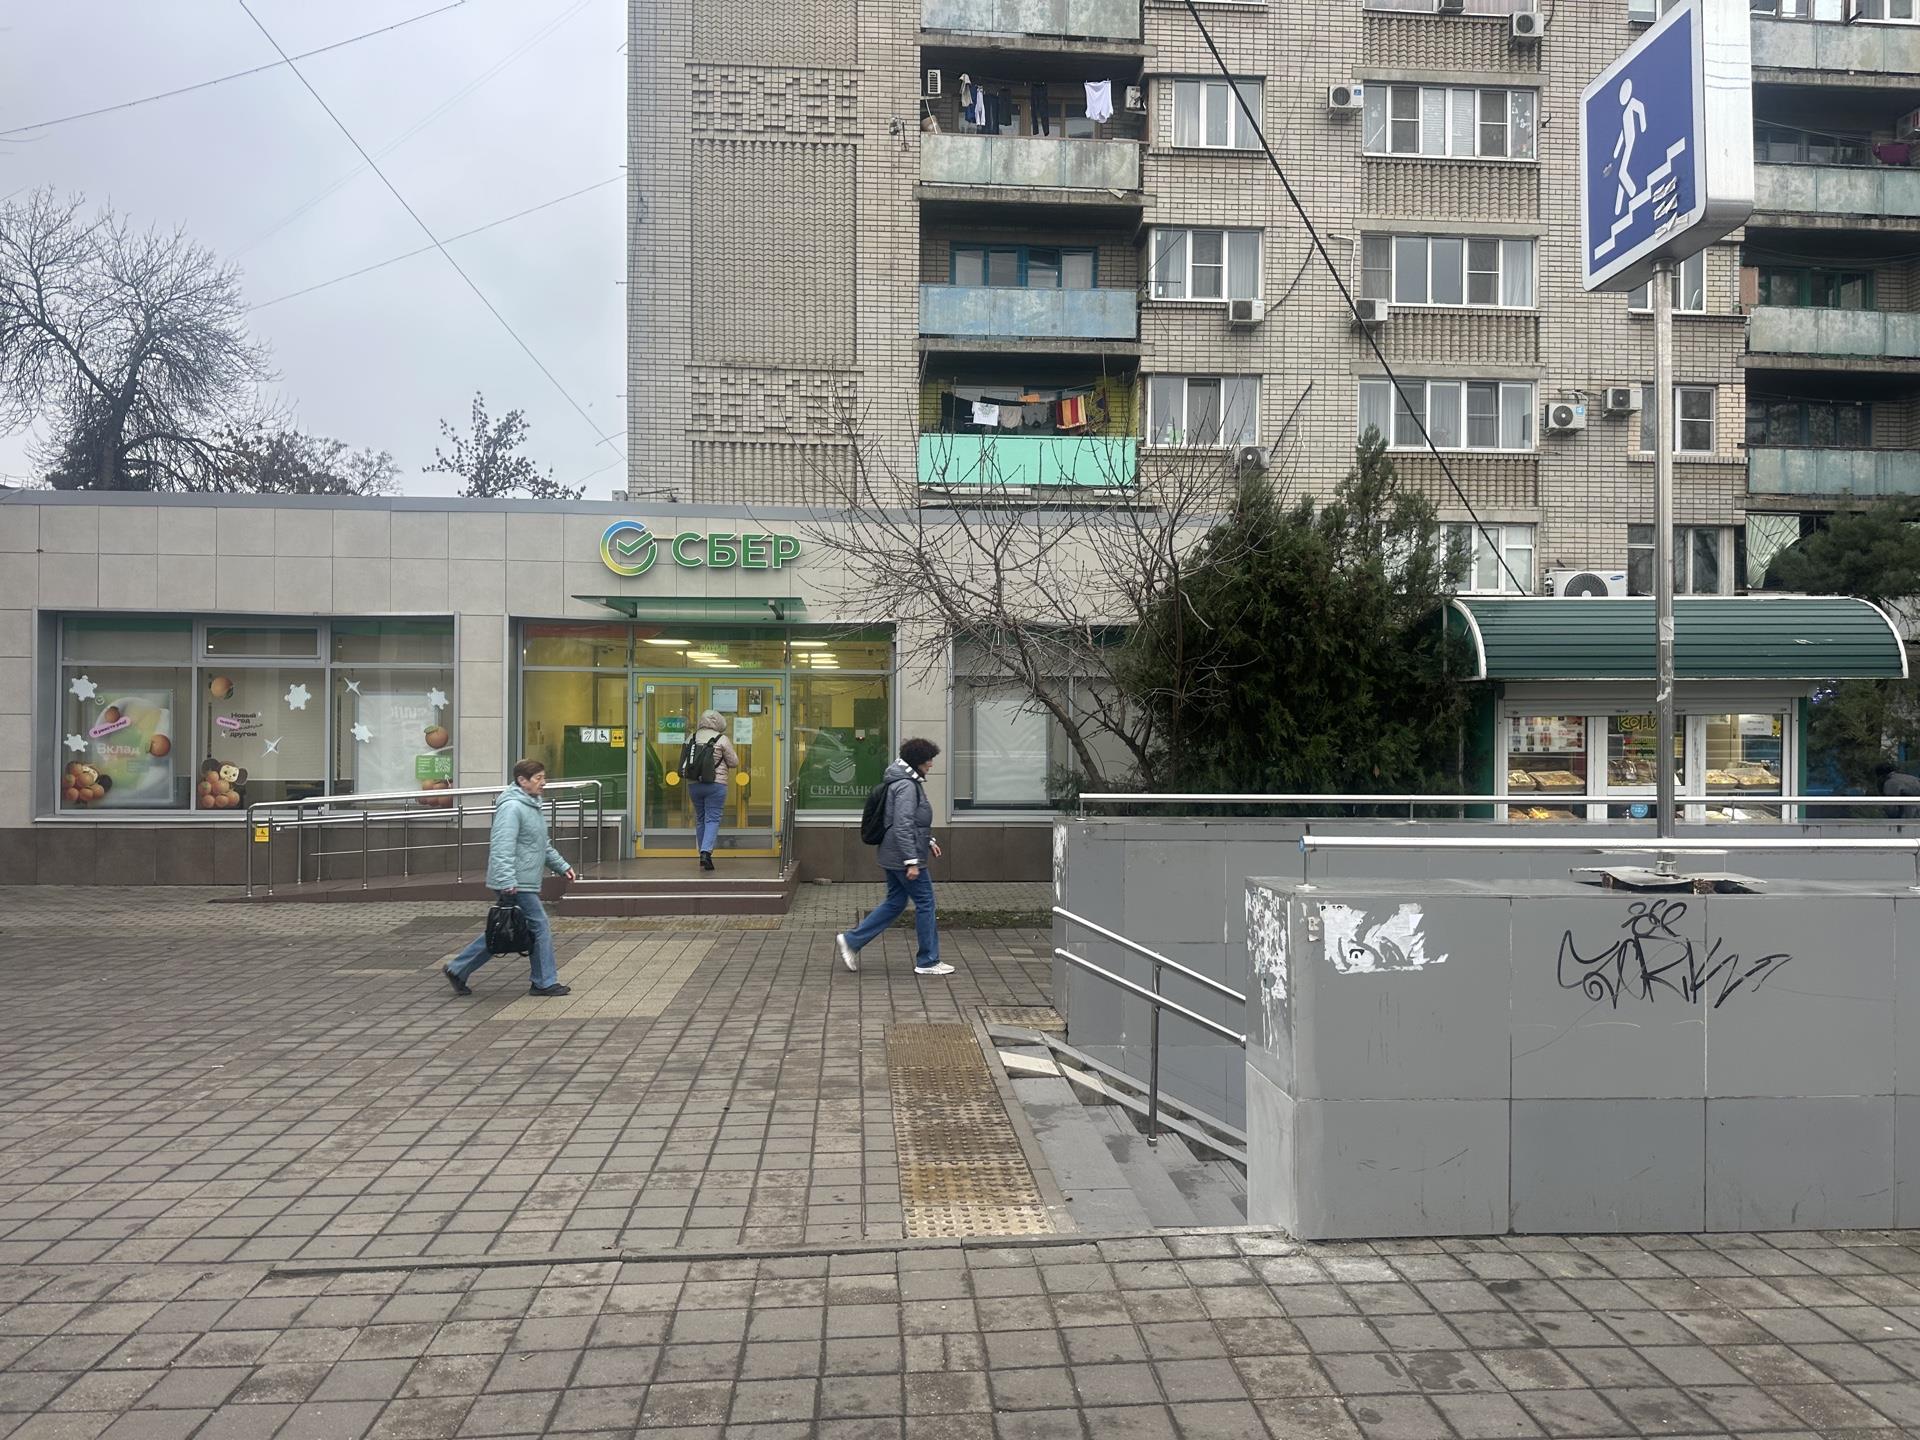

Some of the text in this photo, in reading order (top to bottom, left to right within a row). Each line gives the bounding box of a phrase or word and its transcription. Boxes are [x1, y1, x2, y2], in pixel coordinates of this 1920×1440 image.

[672, 532, 801, 569] СБЕР
[97, 743, 141, 756] Вклад
[809, 784, 873, 796] СБЕРБАНК
